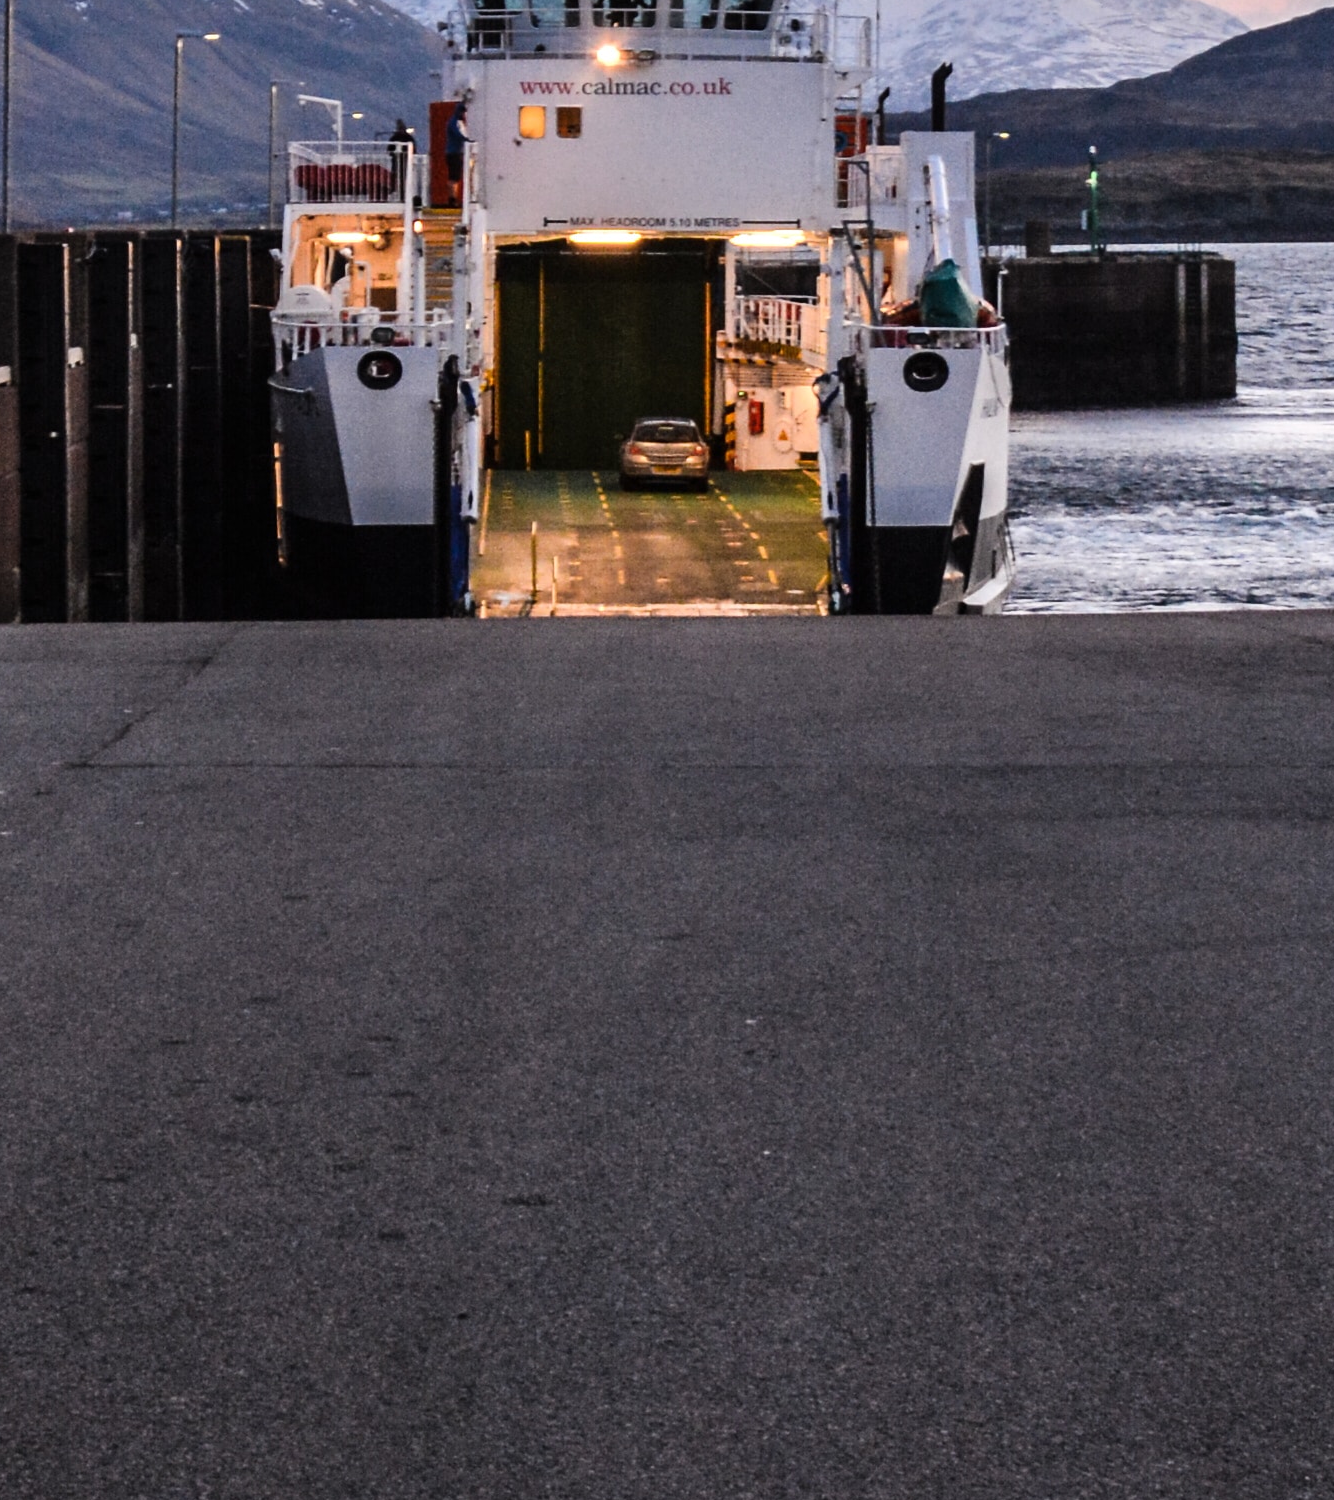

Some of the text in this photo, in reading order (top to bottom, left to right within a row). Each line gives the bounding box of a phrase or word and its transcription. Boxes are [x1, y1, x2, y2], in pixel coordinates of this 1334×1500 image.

[519, 77, 732, 96] www.calmac.co.uk
[601, 217, 666, 227] HEADROOM
[694, 217, 740, 228] METRES
